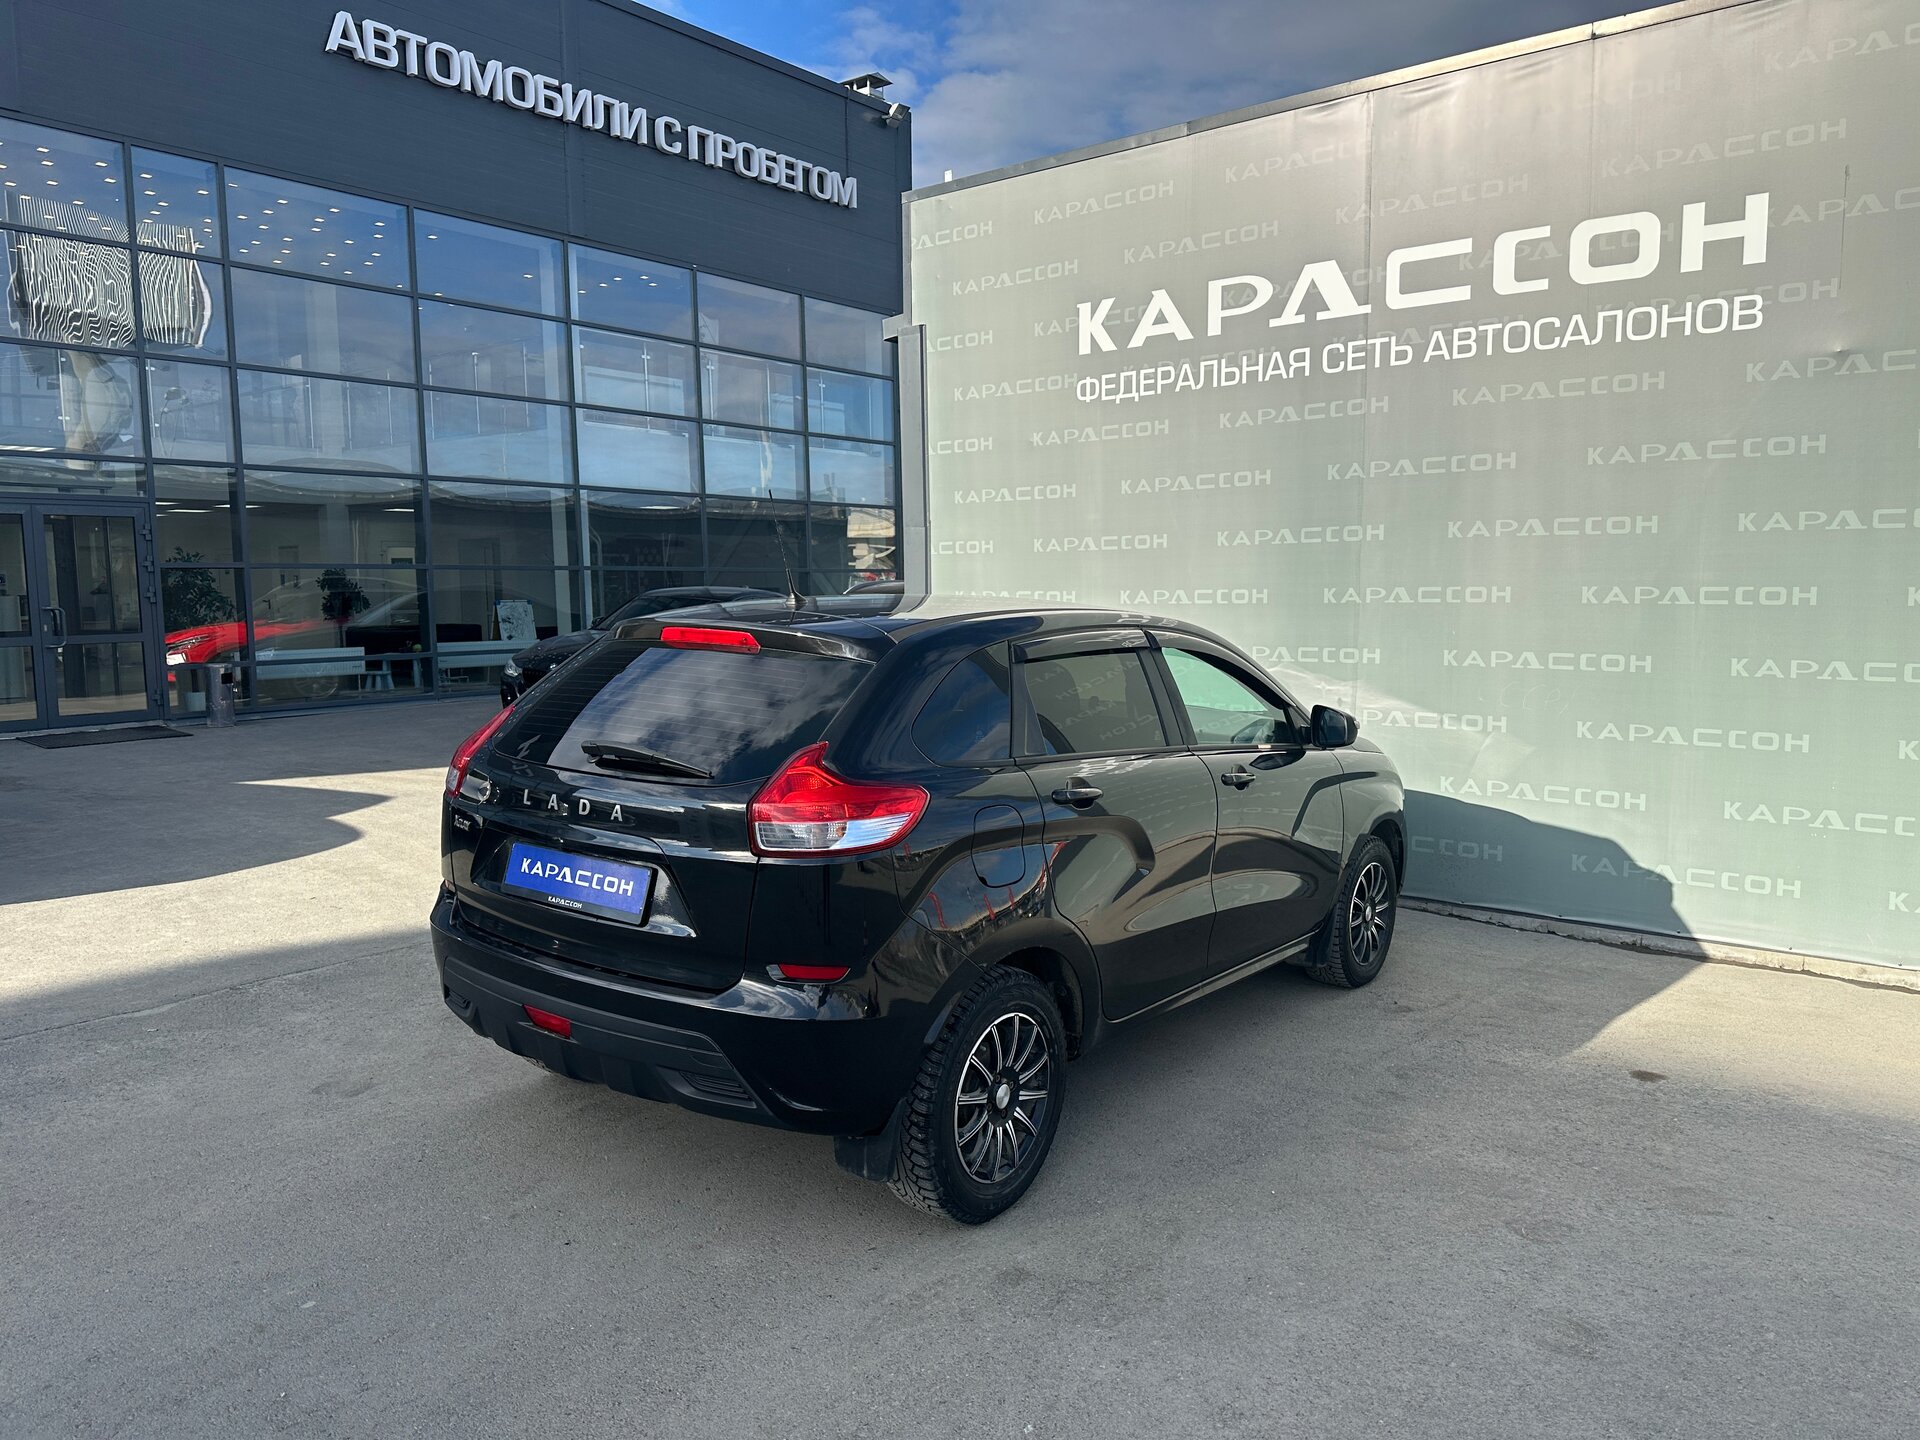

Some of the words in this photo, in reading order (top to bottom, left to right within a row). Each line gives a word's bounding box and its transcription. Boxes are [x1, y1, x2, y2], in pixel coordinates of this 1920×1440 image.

[325, 10, 648, 146] АВТОМОБИЛИ
[655, 115, 682, 155] С
[687, 124, 858, 209] ПРОБЕГОМ
[1033, 179, 1175, 225] КАРАССОН
[912, 220, 994, 250] АССОН
[1124, 220, 1279, 264] КАРАССОН
[952, 258, 1079, 296] КАРАССОН
[1077, 192, 1770, 356] КАРАССОН
[1076, 348, 1312, 404] ФЕДЕРАЛЬНАЯ
[1321, 335, 1414, 374] СЕТЬ
[1423, 294, 1764, 363] АВТОСАЛОНОВ
[1453, 371, 1665, 406] КАРАССОН
[1219, 396, 1389, 429] КАРАССОН
[1033, 419, 1170, 447] КАРАССОН
[1587, 433, 1827, 465] КАРАССОН
[1327, 451, 1517, 481] КАРАССОН
[954, 484, 1077, 504] КАРАССОН
[1121, 469, 1272, 495] КАРАССОН
[1217, 524, 1384, 547] КАРАССОН
[1447, 515, 1658, 538] КАРАССОН
[931, 540, 994, 555] ССОН
[1033, 534, 1168, 553] КАРАССОН
[1119, 588, 1268, 605] КАРАССОН
[1323, 586, 1512, 604] КАРАССОН
[1581, 586, 1817, 606] КАРАССОН
[1252, 645, 1380, 665] РАССОН
[1443, 650, 1652, 673] КАРАССОН
[1362, 708, 1507, 734] РАССОН
[1576, 721, 1810, 753] КАРАССОН
[523, 788, 624, 822] LADA
[1439, 775, 1647, 812] КАРАССОН
[1410, 835, 1503, 862] ССОН
[520, 857, 634, 897] КАРАССОН
